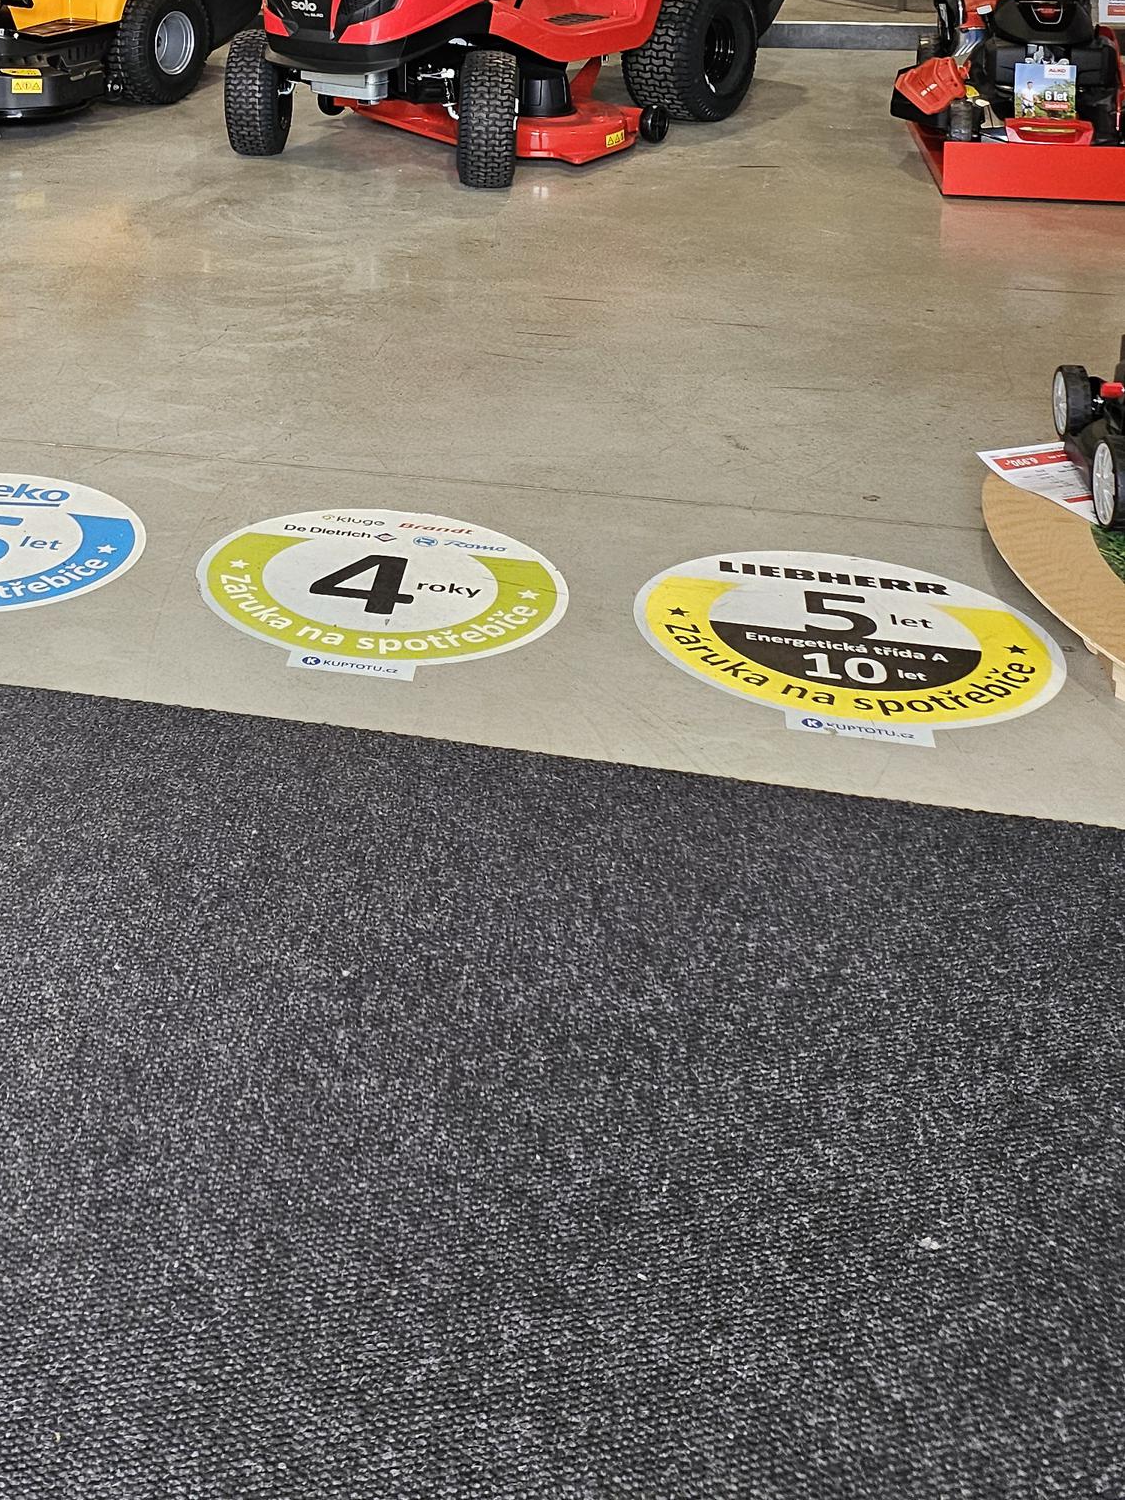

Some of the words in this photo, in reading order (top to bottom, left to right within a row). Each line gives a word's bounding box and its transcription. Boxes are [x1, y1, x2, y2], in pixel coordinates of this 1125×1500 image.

[291, 0, 317, 11] solo
[1045, 90, 1052, 101] 6
[1053, 91, 1068, 101] let
[284, 523, 307, 533] De
[309, 526, 372, 539] Dietrich
[444, 540, 508, 552] Romo
[335, 515, 385, 527] kluge
[398, 522, 474, 536] Brandt
[19, 535, 63, 551] let
[309, 554, 415, 615] 4
[416, 580, 482, 599] roky
[719, 560, 950, 597] LIEBHERR
[220, 573, 293, 631] Záruka
[296, 623, 345, 646] na
[356, 605, 539, 655] spotřebiče
[803, 590, 878, 640] 5
[890, 613, 935, 630] let
[745, 631, 869, 655] Energetická
[873, 644, 927, 662] třída
[931, 652, 949, 664] A
[322, 659, 399, 674] KUPTOTU.cz
[664, 622, 770, 688] Záruka
[781, 684, 837, 708] na
[854, 660, 1037, 718] spotřebiče
[802, 652, 889, 685] 10
[897, 668, 928, 682] let
